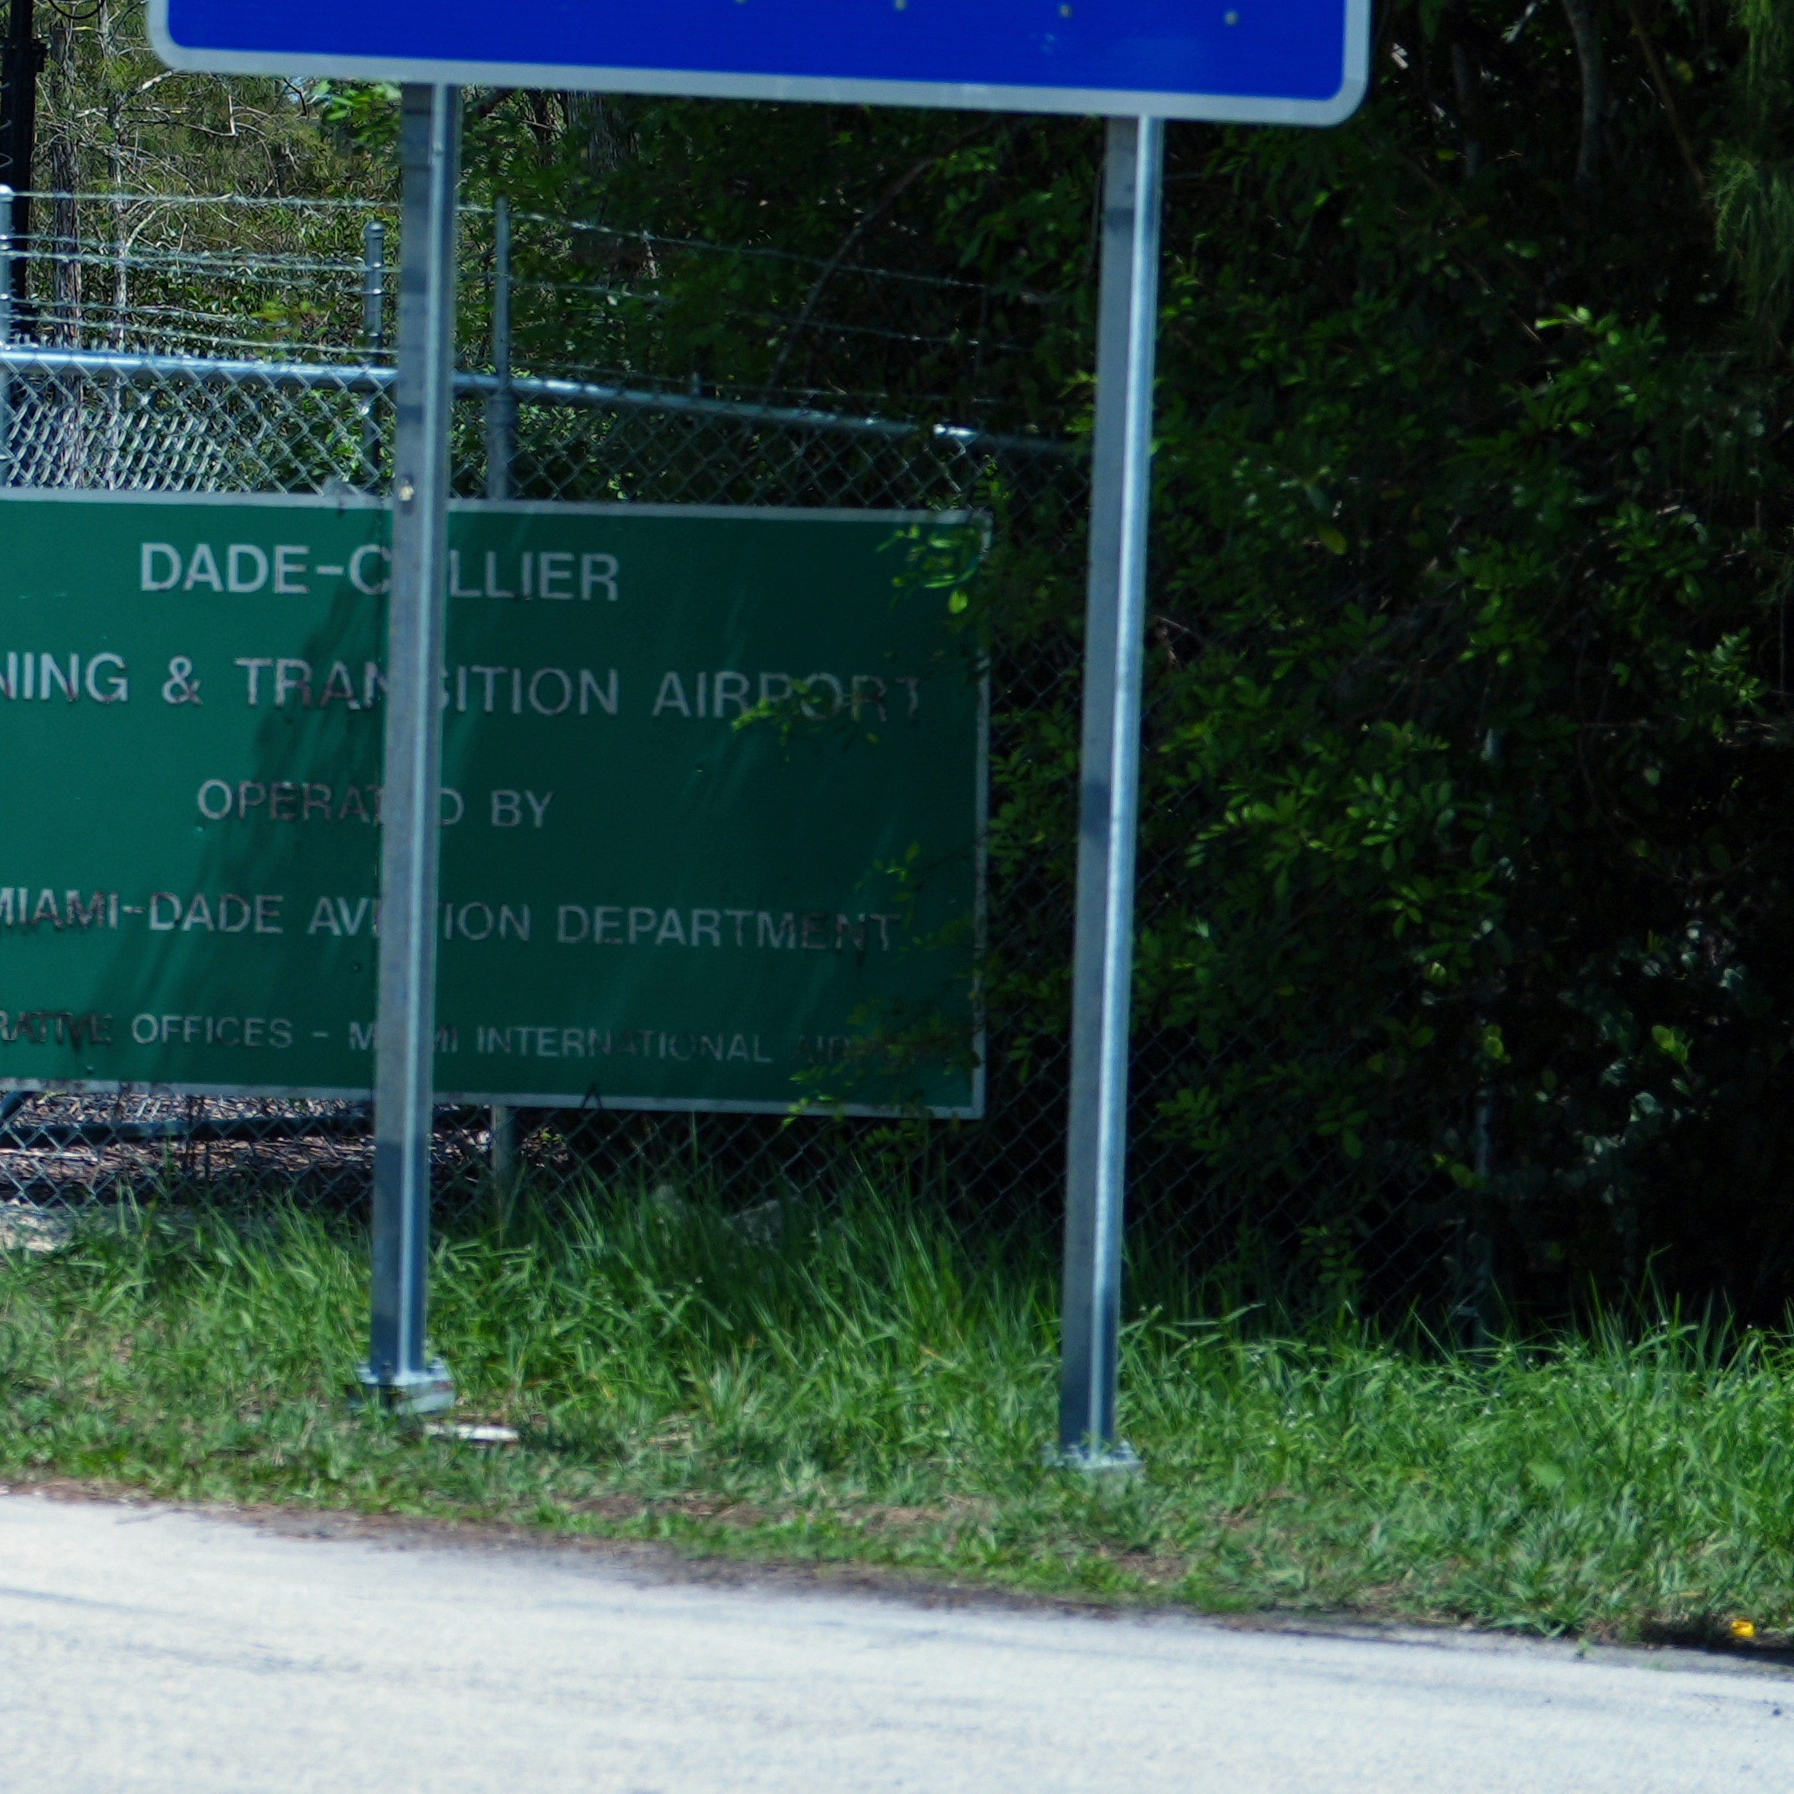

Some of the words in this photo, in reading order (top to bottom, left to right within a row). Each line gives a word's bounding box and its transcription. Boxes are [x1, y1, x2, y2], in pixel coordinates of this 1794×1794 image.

[140, 542, 621, 602] DADE-CLLIER
[162, 654, 204, 706] &
[234, 656, 620, 717] TRANITION
[652, 669, 921, 724] AIRPORT
[196, 778, 465, 827] OPERATD
[490, 788, 556, 830] BY
[307, 895, 532, 944] AVIION
[556, 904, 902, 953] DEPARTMENT
[131, 1012, 295, 1050] OFFICES
[477, 1025, 773, 1065] INTERNATIONAL
